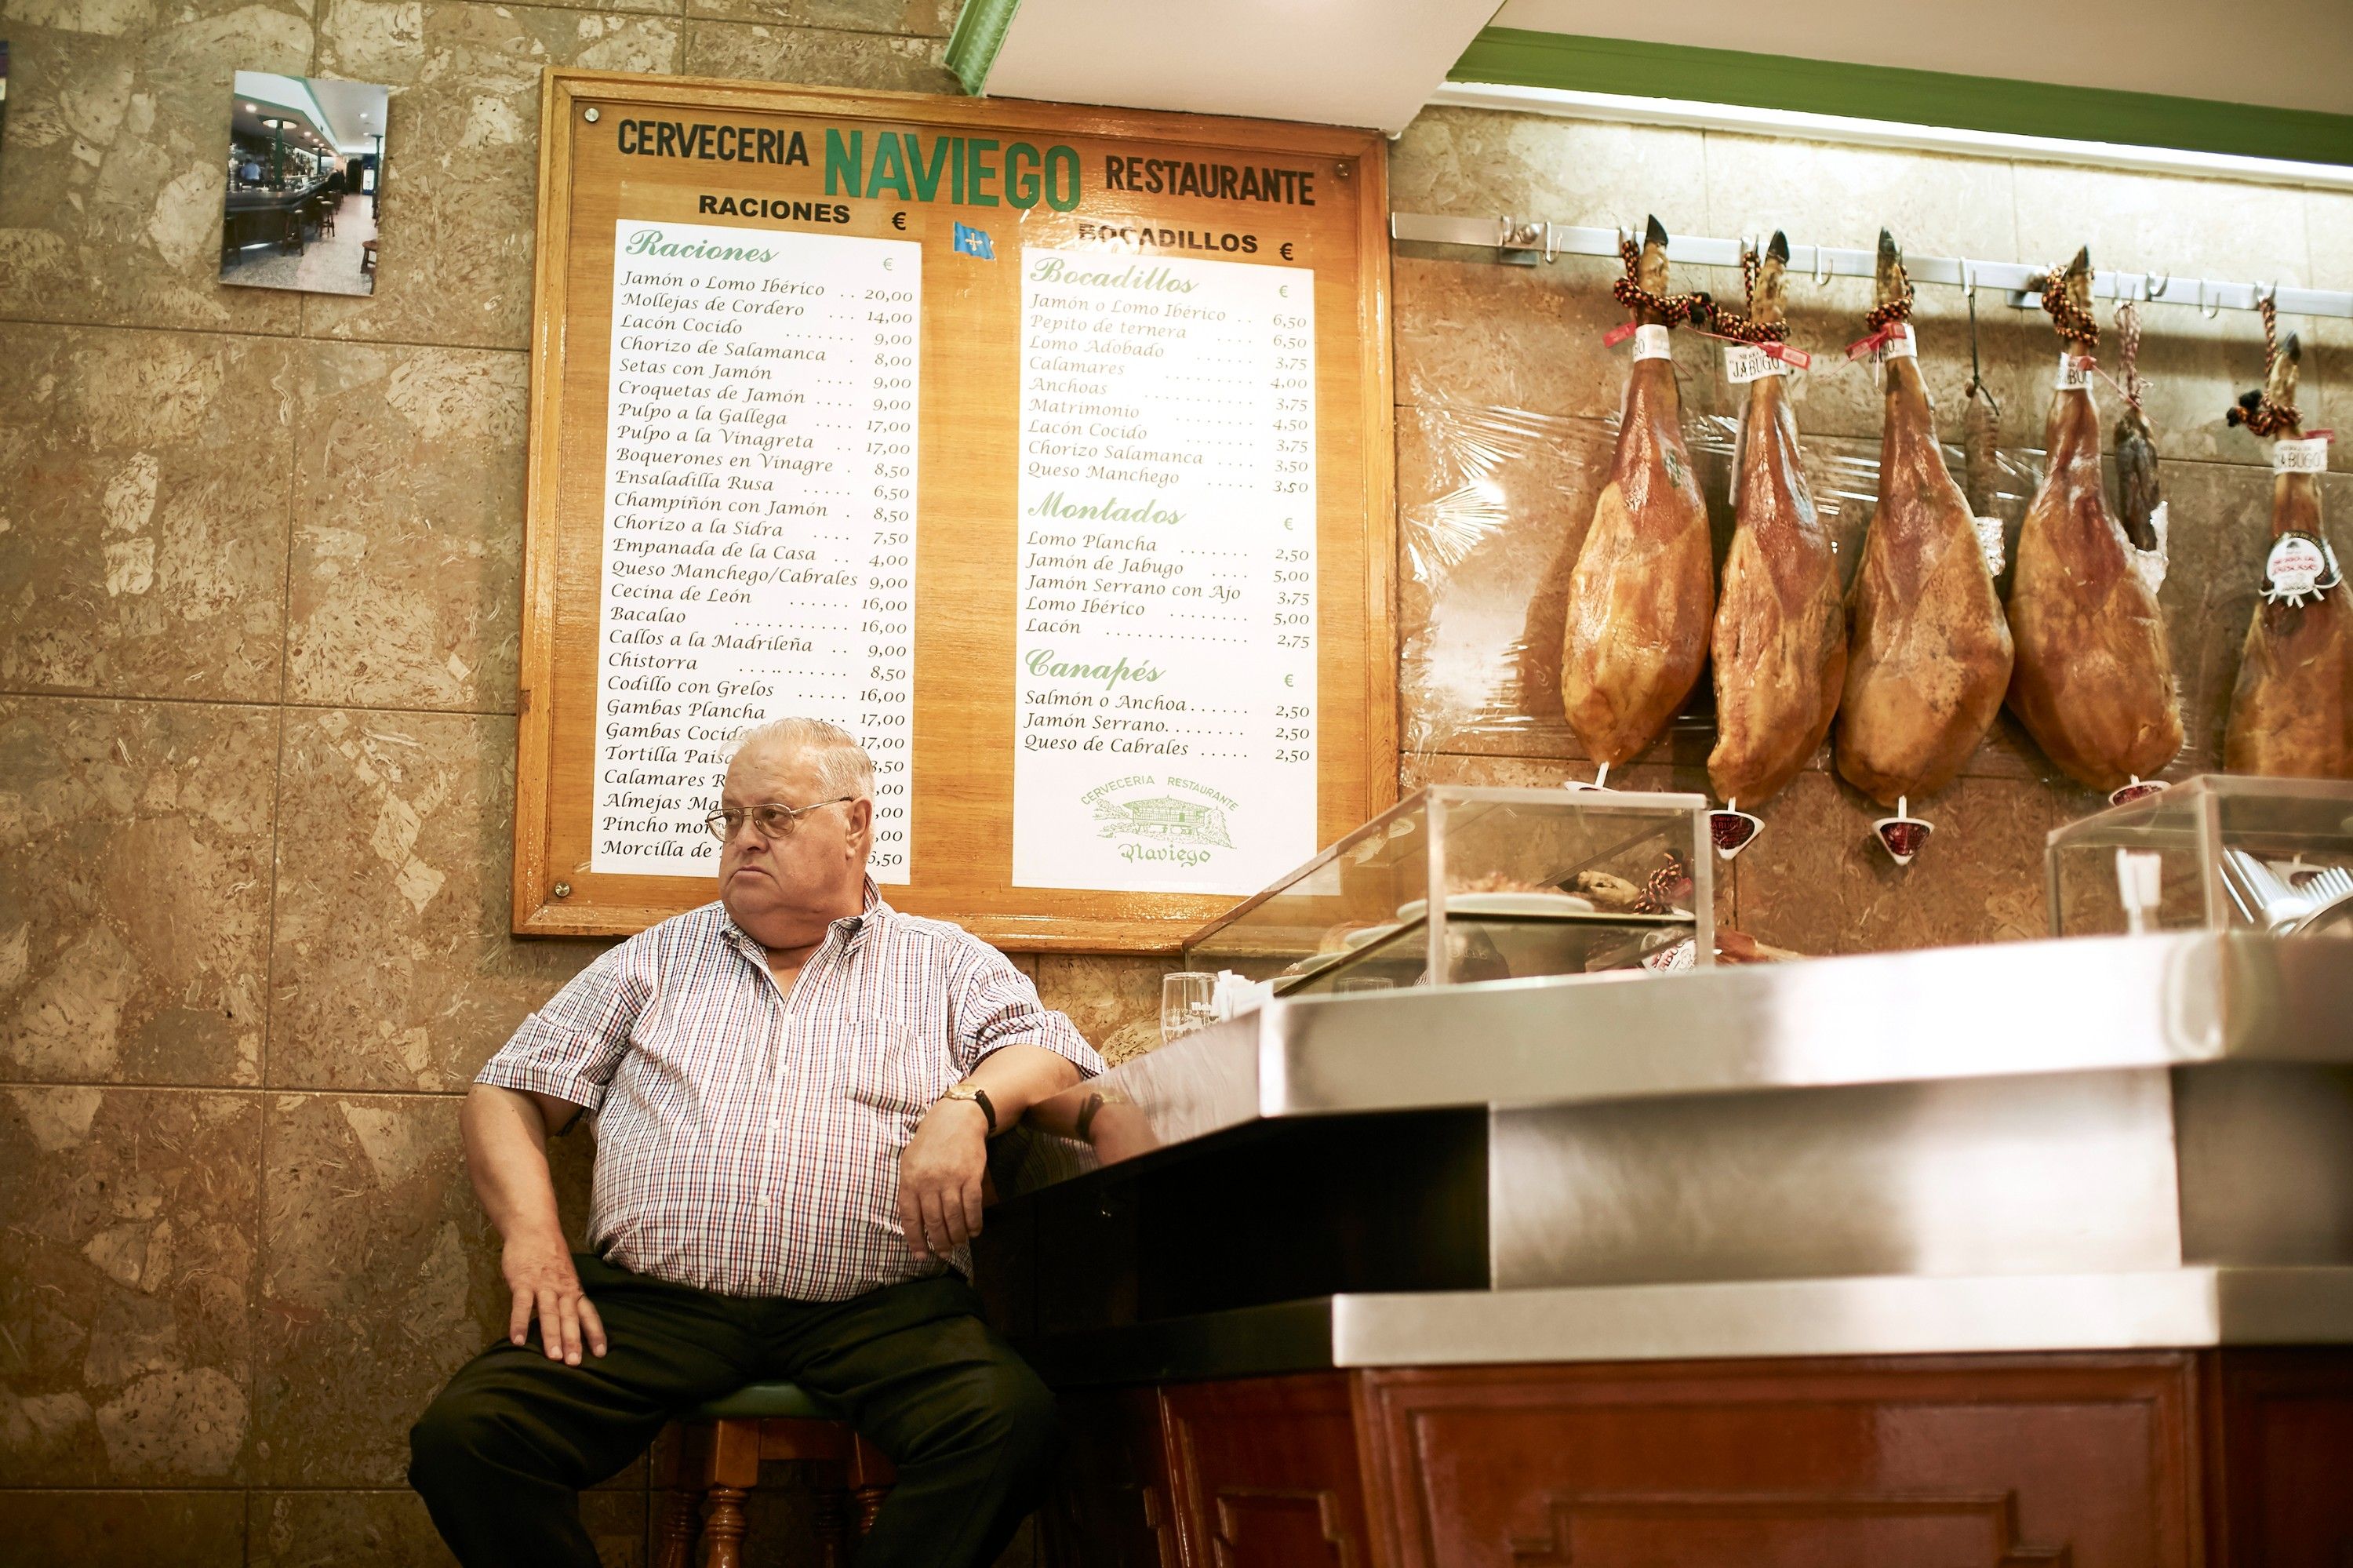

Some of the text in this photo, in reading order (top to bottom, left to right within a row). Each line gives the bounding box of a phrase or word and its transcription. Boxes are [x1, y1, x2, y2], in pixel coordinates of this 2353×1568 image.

[617, 118, 1316, 213] CERVECERIA NAVIEGO RESTAURANTE
[698, 195, 907, 231] RACIONES €
[625, 229, 780, 263] Raciones
[1078, 223, 1293, 261] BOCADILLOS €
[620, 271, 912, 303] Jamón Lomo Ibérico 20,00
[1028, 256, 1199, 294] Bocadillos
[621, 292, 912, 324] Mollejas de Cordero 14,00
[1028, 293, 1307, 329] Jamón Lomo Ibérico 6,50
[620, 314, 912, 345] Lacón Cocido 9,00
[1030, 314, 1307, 350] Pepito de ternera 6,50
[620, 335, 911, 367] Chorizo de Salamanca 8,00
[1028, 335, 1307, 371] Lomo Adobado 3,75
[619, 358, 911, 389] Setas con Jamón 9,00
[1029, 355, 1307, 389] Calamares 4,00
[619, 380, 911, 411] Croquetas de Jamón 9,00
[1028, 377, 1308, 412] Anchoas 3,75
[618, 402, 911, 433] Pulpo la Gallega 17,00
[1028, 398, 1308, 431] Matrimonio 4,50
[616, 424, 910, 455] Pulpo la Vinagreta 17,00
[1027, 419, 1308, 453] Lacón Cocido 3,75
[616, 447, 909, 478] Boquerones en Vinagre 8,50
[1028, 438, 1308, 473] Chorizo Salamanca 3,50
[616, 470, 909, 500] Ensaladilla Rusa 6,50
[1027, 461, 1308, 493] Queso Manchego 3,50
[614, 490, 909, 522] Champiñón con Jamón 8,50
[1027, 490, 1187, 525] Montados
[613, 513, 908, 545] Chorizo la Sidra 7,50
[613, 537, 907, 567] Empanada de la Casa 4,00
[1026, 530, 1310, 562] Lomo Plancha 2,50
[611, 560, 907, 590] Queso Manchego/Cabrales 9,00
[1024, 552, 1309, 584] Jamón de Jabugo 5,00
[611, 583, 907, 613] Cecina de León 16,00
[1024, 574, 1310, 606] Jamón Serrano con Ajo 3,75
[610, 606, 907, 635] Bacalao 16,00
[1024, 595, 1310, 627] Lomo Ibérico 5,00
[609, 628, 907, 657] Callos la Madrileña 9,00
[1024, 617, 1310, 649] Lacón 2,75
[609, 650, 906, 682] Chistorra 8,50
[1024, 649, 1167, 691] Canapés
[608, 675, 906, 704] Codillo con Grelos 16,00
[1024, 689, 1310, 719] Salmón Anchoa 2,50
[607, 698, 905, 728] Gambas Plancha 17,00
[1022, 712, 1310, 741] Jamón Serrano 2,50
[606, 722, 904, 750] Gambas 17,00
[1024, 733, 1310, 763] Queso de Cabrales 2,50
[605, 744, 678, 762] Tortilla
[604, 768, 705, 787] Calamares
[1081, 775, 1239, 811] CERVECERIA RESTAURANTE
[602, 791, 682, 814] Almejas
[602, 816, 668, 833] Pincho
[601, 840, 711, 858] Morcilla de
[1117, 842, 1212, 868] Naviego
